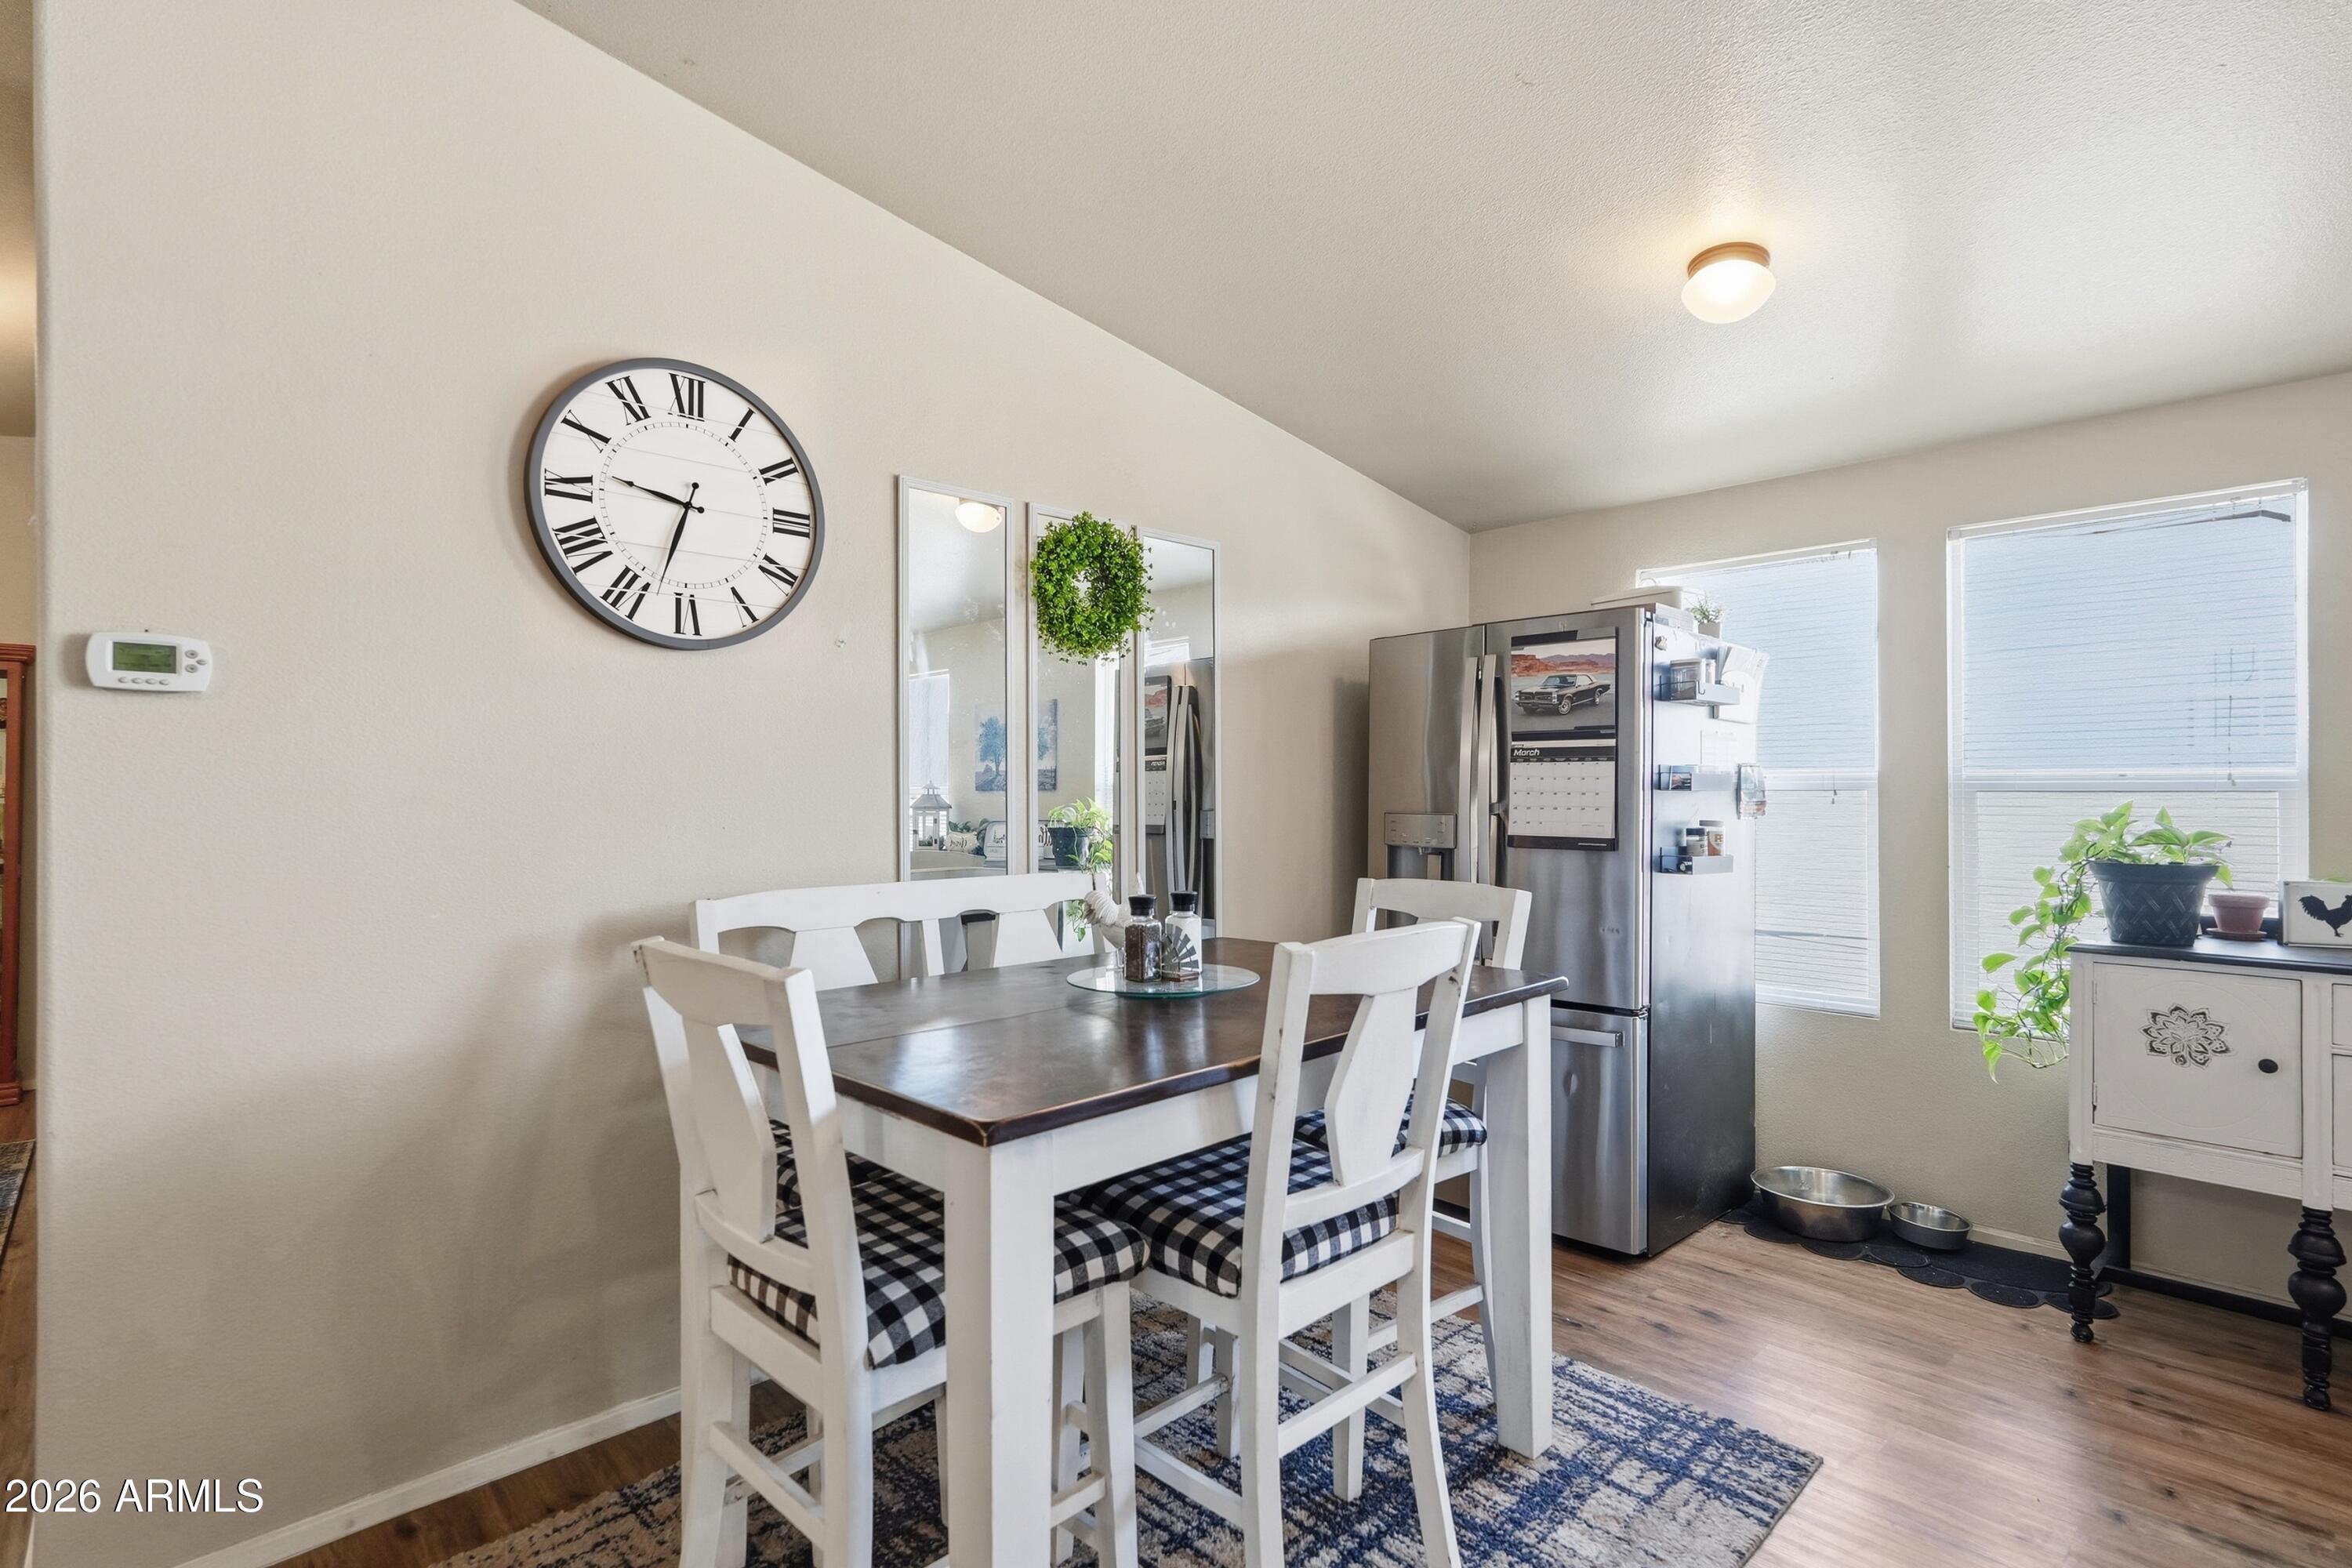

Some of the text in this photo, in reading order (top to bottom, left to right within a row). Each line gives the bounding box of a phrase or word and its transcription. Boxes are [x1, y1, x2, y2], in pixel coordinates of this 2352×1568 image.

[605, 376, 652, 426] XI
[668, 372, 706, 422] XII
[561, 409, 612, 453] X
[728, 408, 756, 441] I
[545, 468, 593, 503] IX
[758, 457, 800, 485] II
[772, 507, 810, 539] III
[552, 515, 613, 576] VIII
[599, 564, 651, 621] VII
[673, 592, 702, 636] VI
[730, 586, 759, 627] V
